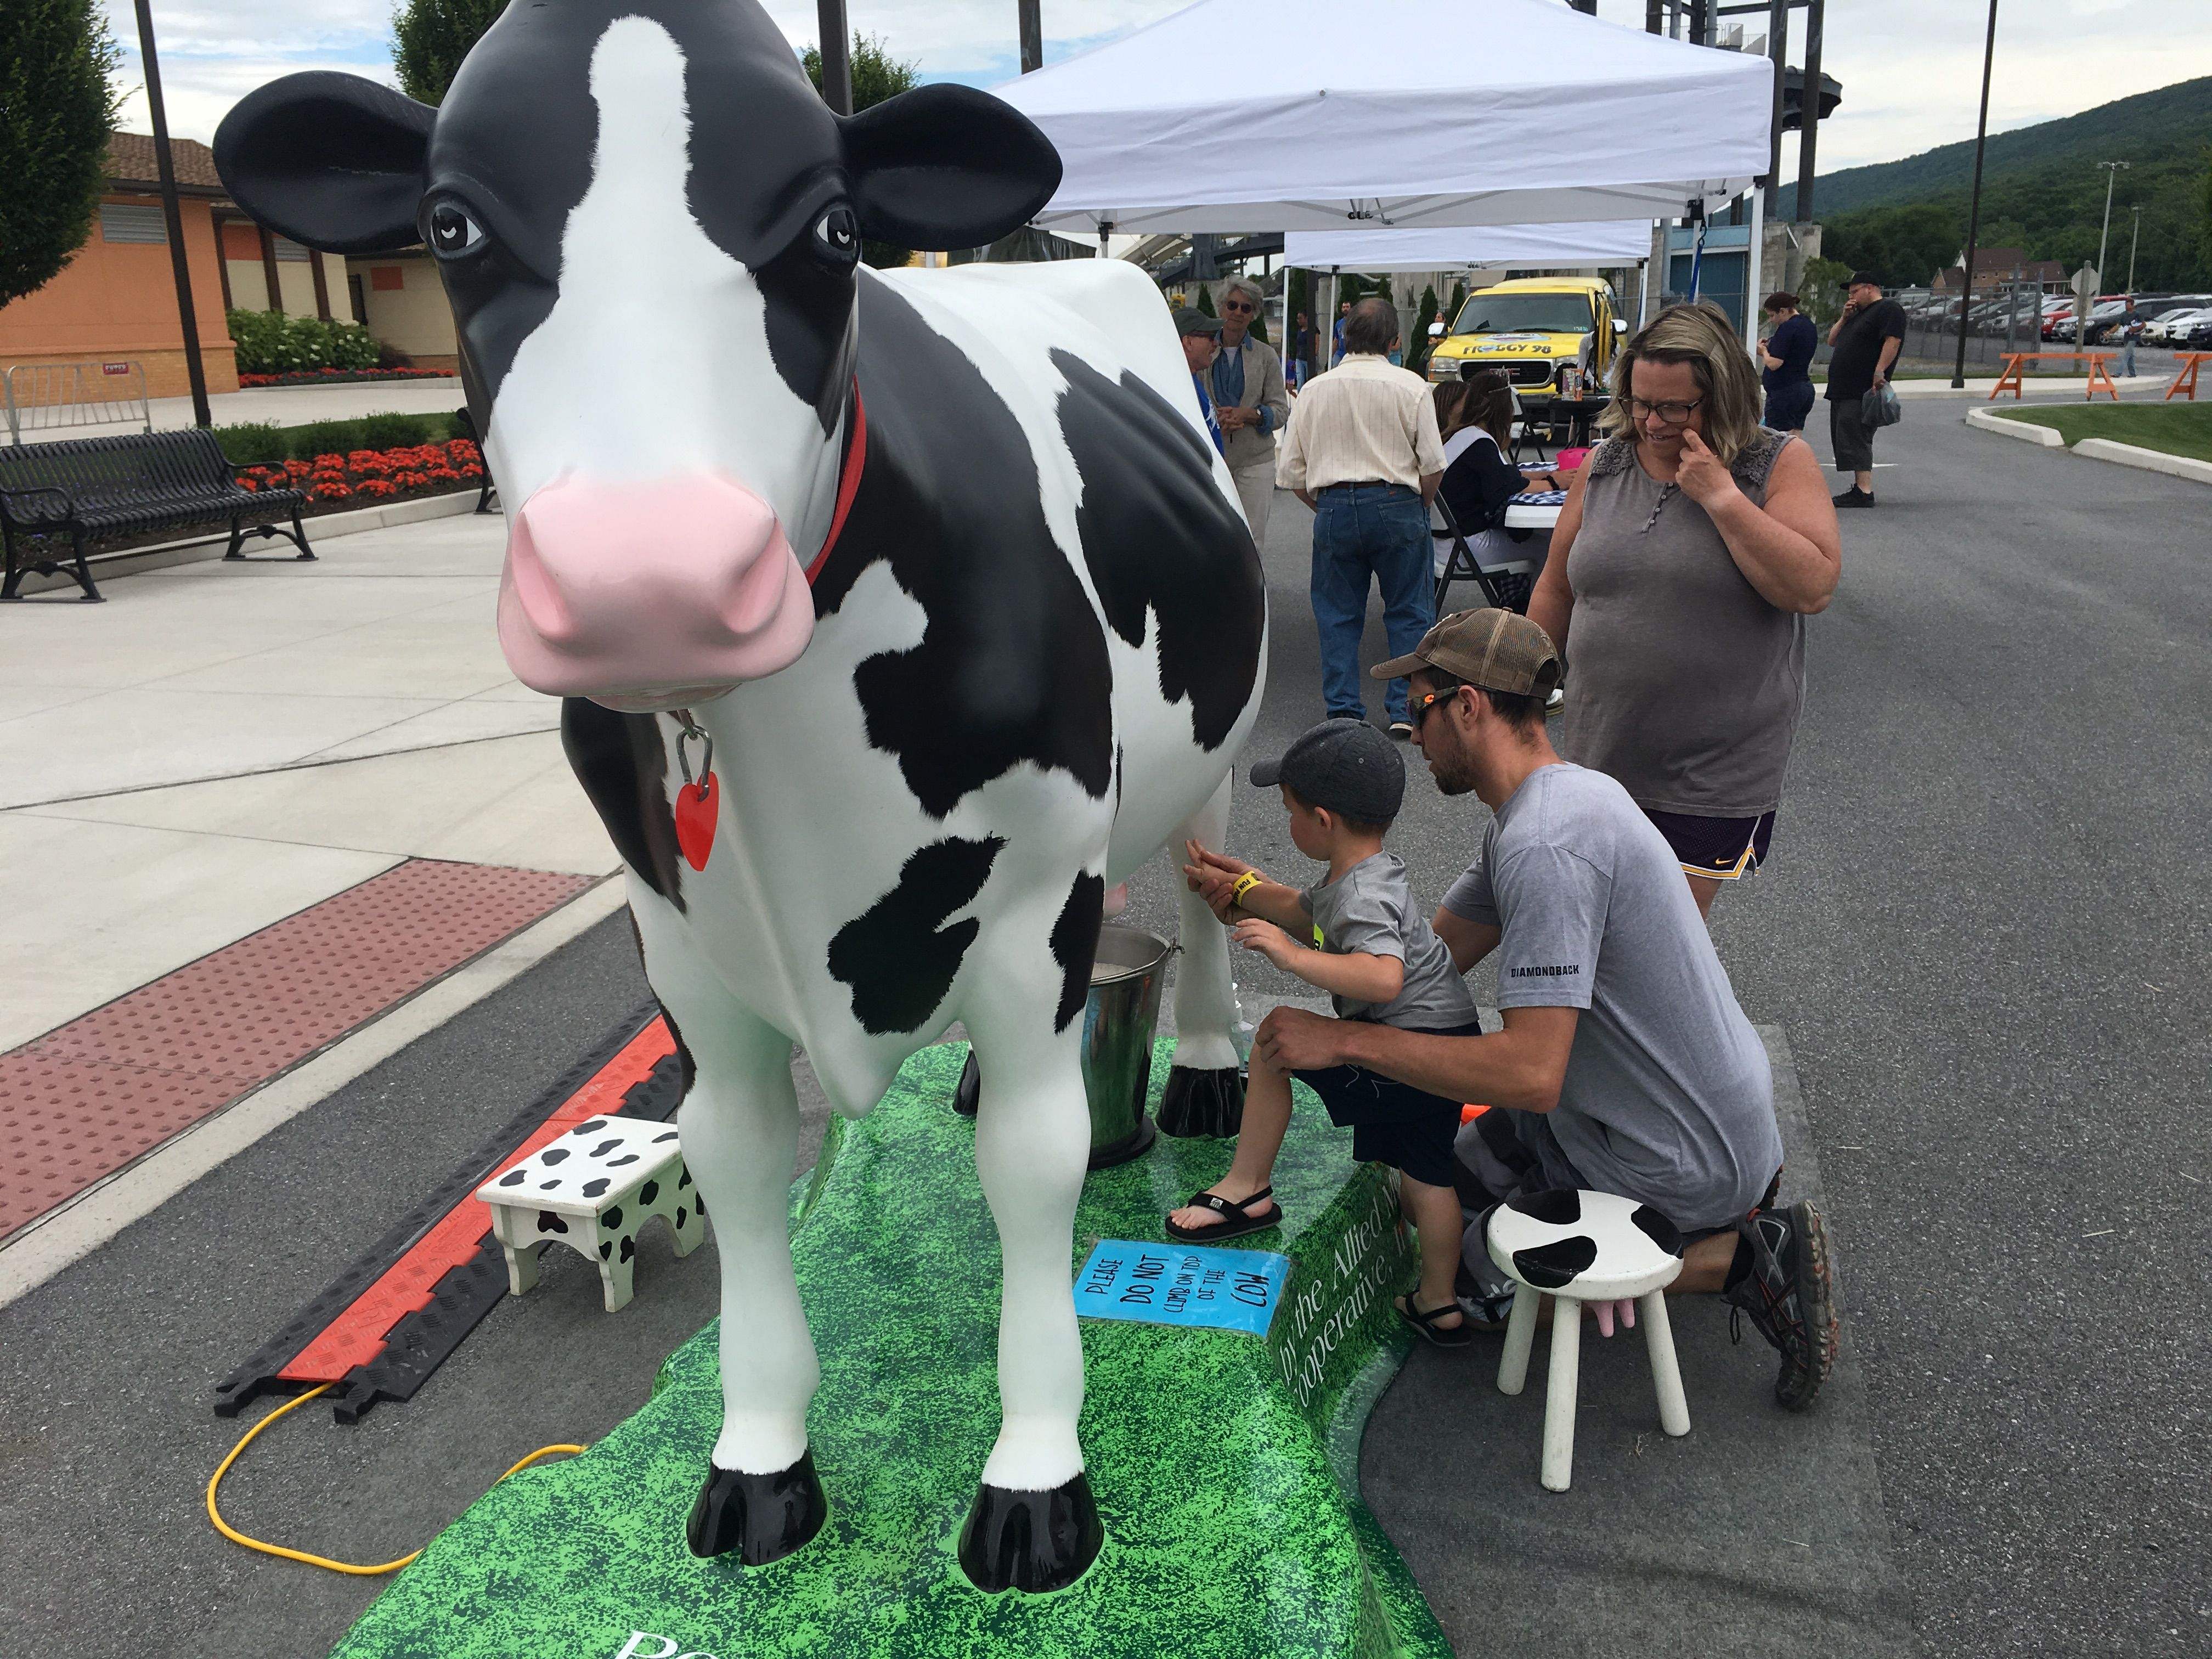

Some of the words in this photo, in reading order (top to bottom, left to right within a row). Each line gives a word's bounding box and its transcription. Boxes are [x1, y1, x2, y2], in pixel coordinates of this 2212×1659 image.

[1531, 345, 1552, 354] 98
[1238, 879, 1251, 890] FUN
[1511, 964, 1579, 978] DIAMONDBACK
[1132, 1254, 1169, 1280] NOT
[1181, 1256, 1203, 1270] TOP
[1084, 1259, 1124, 1295] PLEASE
[1175, 1273, 1196, 1285] ON
[1203, 1269, 1226, 1284] THE
[1119, 1284, 1154, 1304] DO
[1197, 1287, 1216, 1300] OF
[1231, 1272, 1270, 1307] COW
[1279, 1322, 1297, 1386] by
[1295, 1279, 1324, 1339] the
[1333, 1197, 1383, 1292] Allied
[1163, 1287, 1190, 1313] CLIMB
[1293, 1255, 1393, 1408] ooperative,
